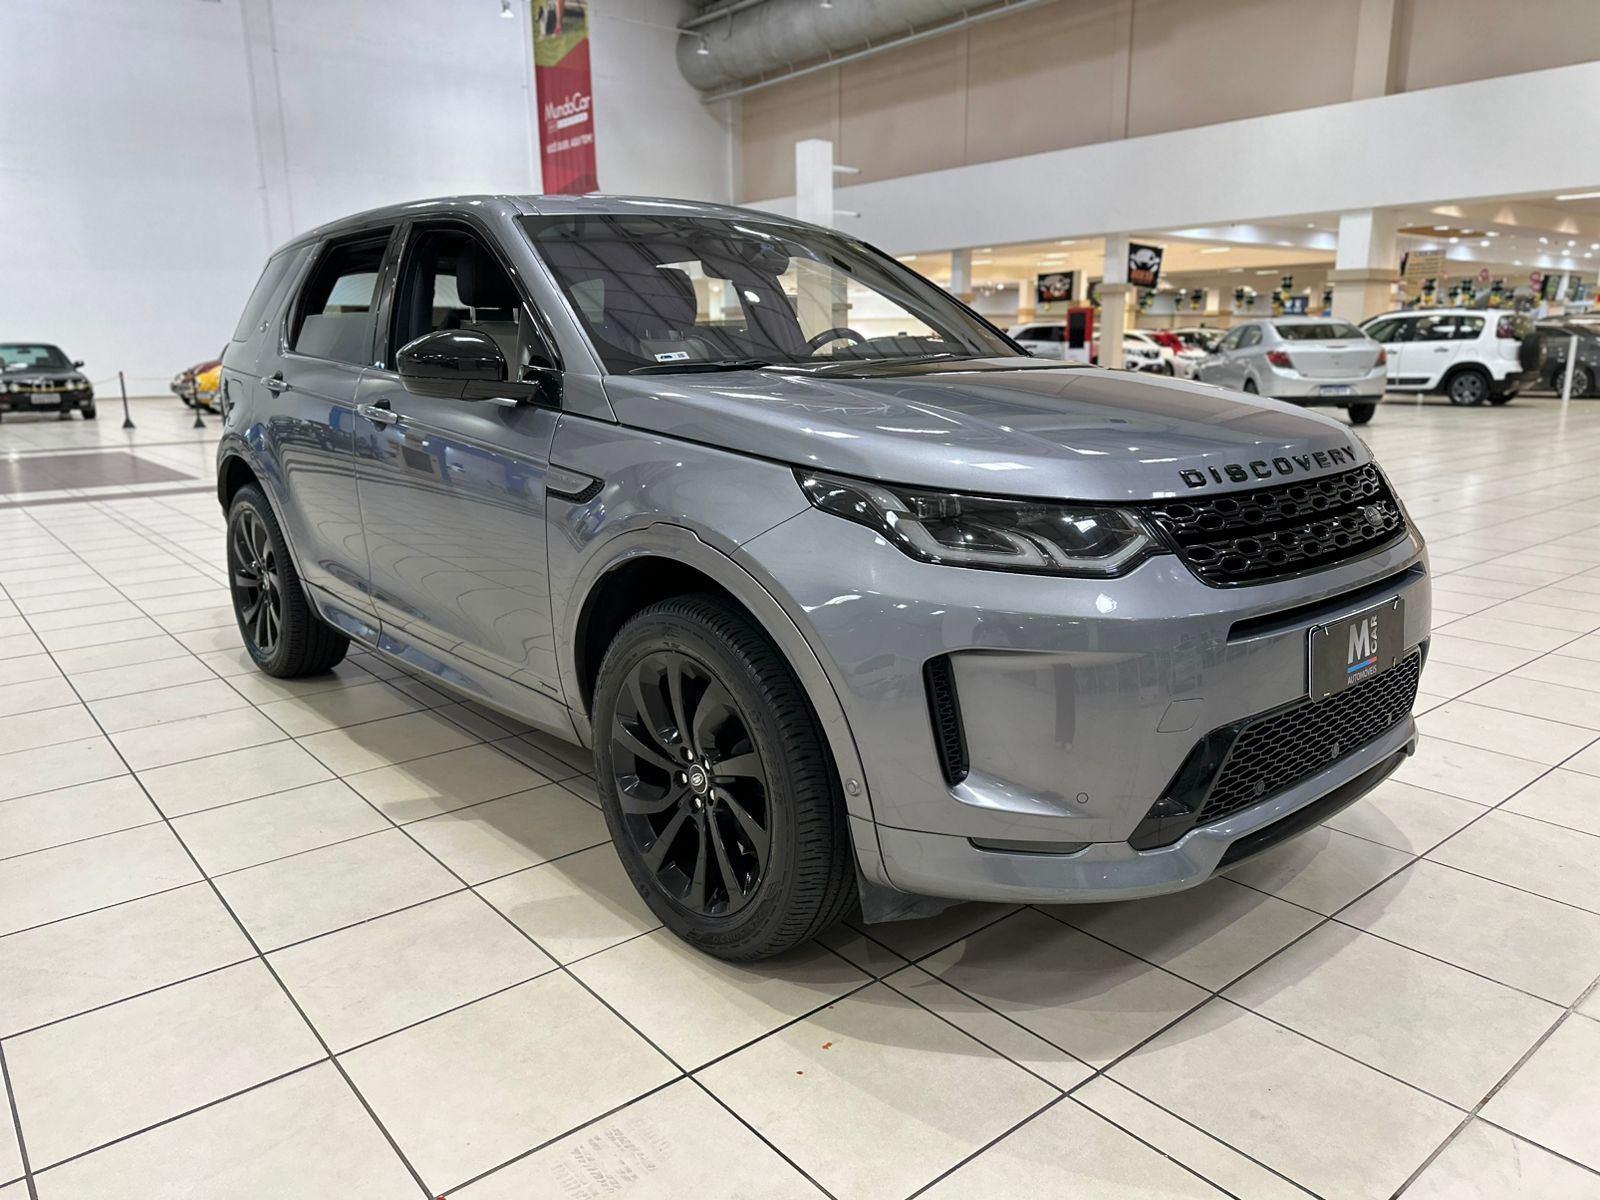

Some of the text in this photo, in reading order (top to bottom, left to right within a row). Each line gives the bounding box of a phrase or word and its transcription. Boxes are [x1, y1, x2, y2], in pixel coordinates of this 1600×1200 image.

[545, 92, 590, 122] MundoCar
[1179, 446, 1356, 488] DISCOVERY
[1348, 619, 1371, 664] M
